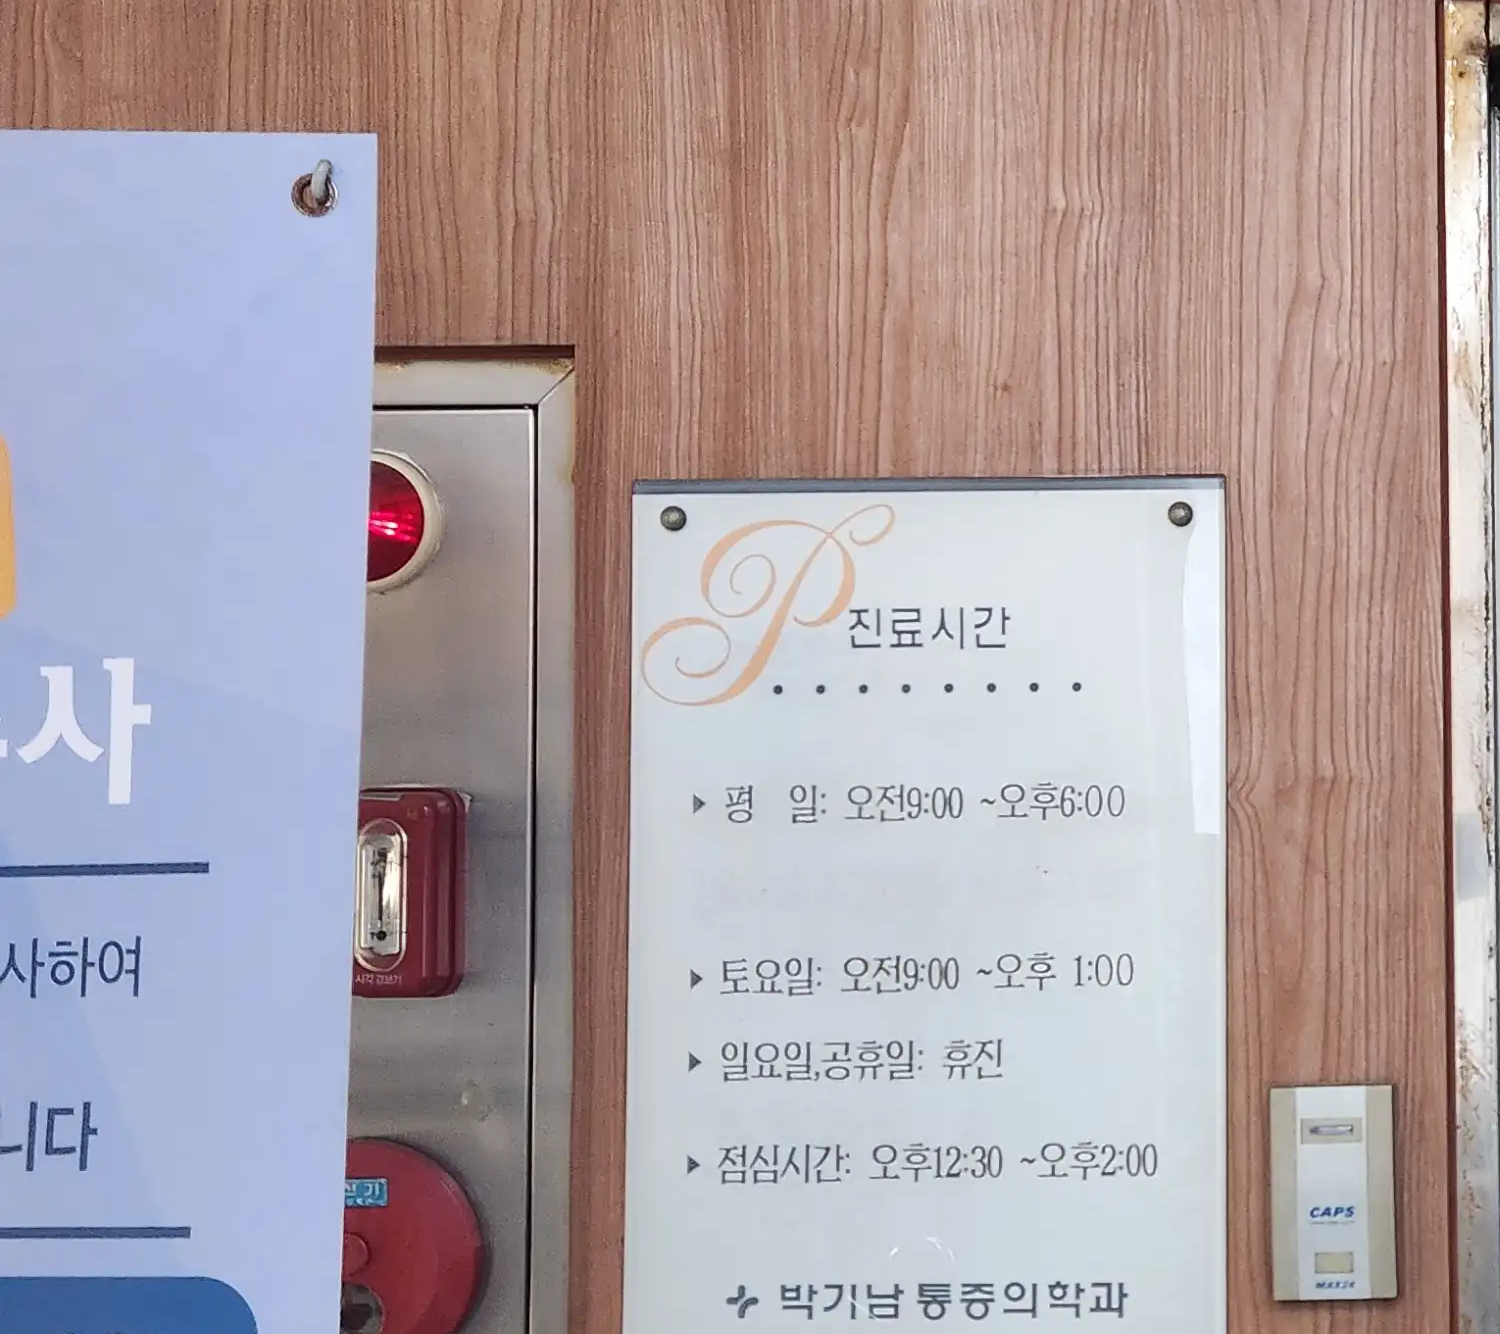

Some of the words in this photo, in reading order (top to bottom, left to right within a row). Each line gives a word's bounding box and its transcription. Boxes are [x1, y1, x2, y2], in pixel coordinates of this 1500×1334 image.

[848, 607, 1011, 650] 진료시간
[0, 657, 151, 805] 사
[720, 957, 822, 997] 토요일:
[942, 1038, 1005, 1080] 휴진
[1310, 1206, 1355, 1219] CAPS
[779, 1279, 1130, 1322] 박기남통증의학과
